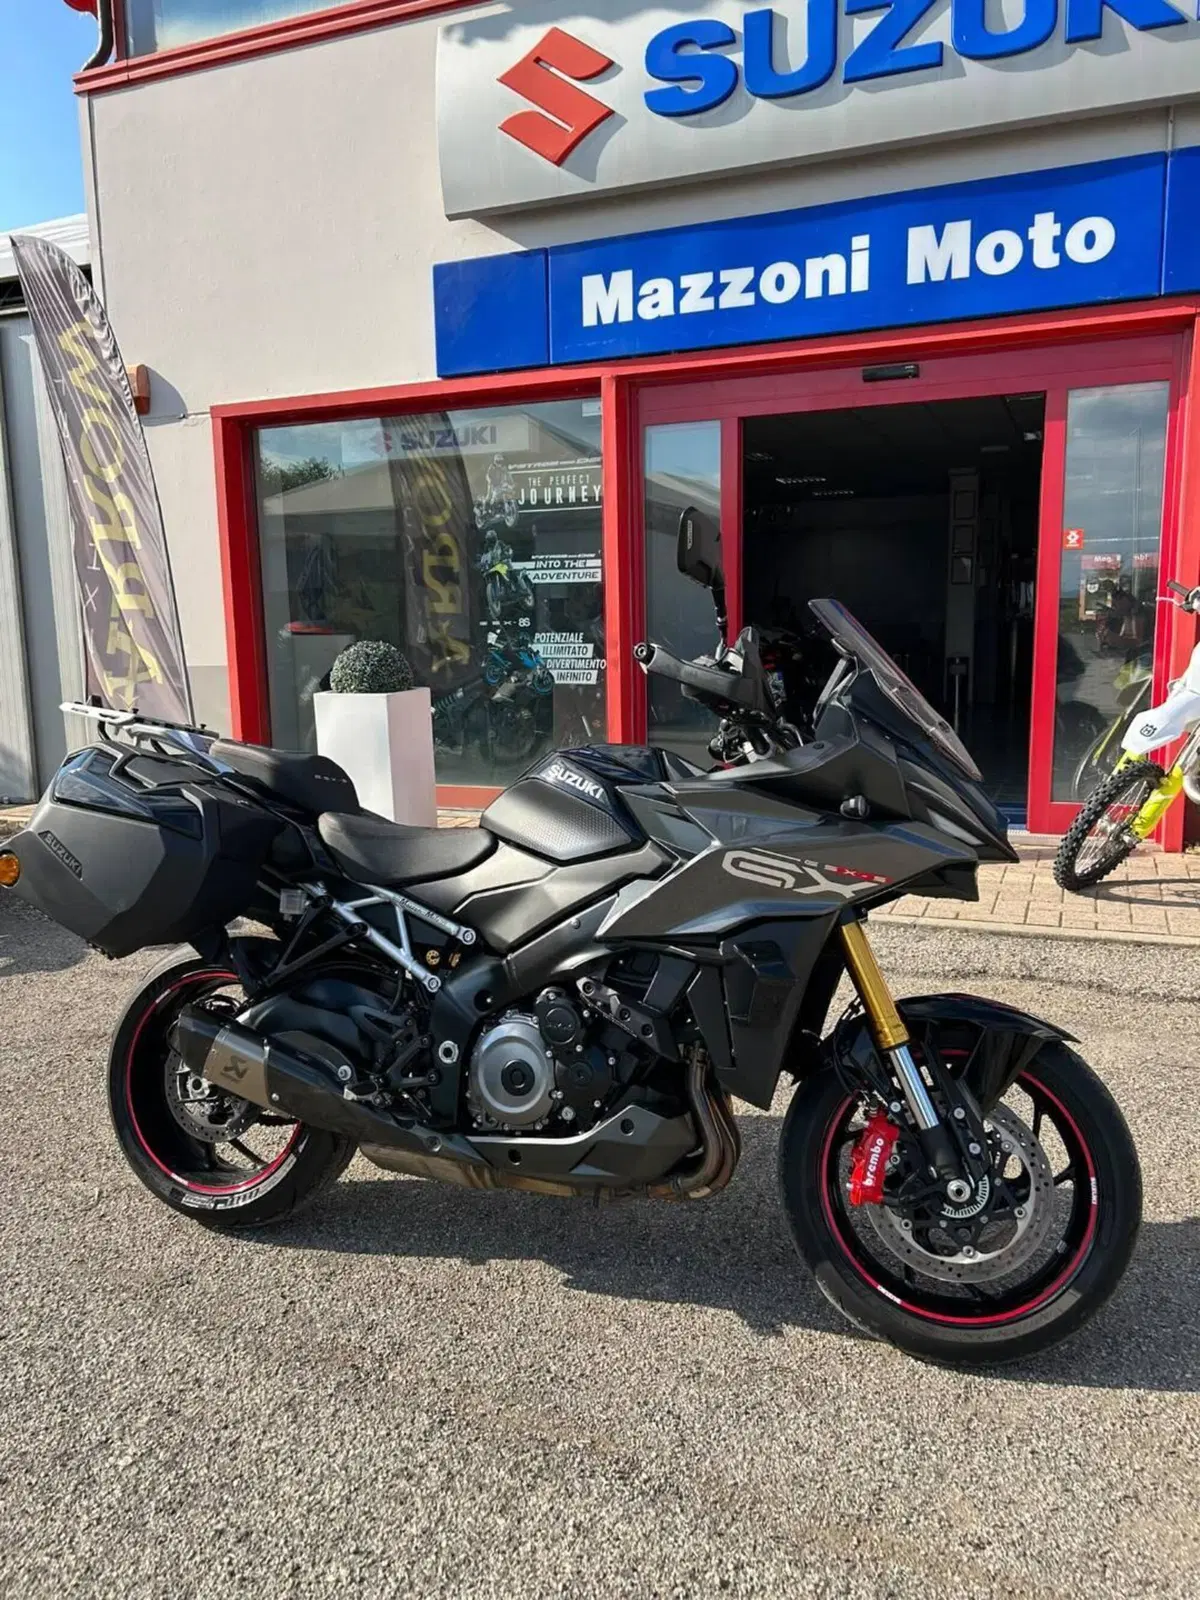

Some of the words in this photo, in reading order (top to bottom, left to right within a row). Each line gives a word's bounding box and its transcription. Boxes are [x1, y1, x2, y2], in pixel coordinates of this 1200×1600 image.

[643, 0, 1200, 117] SUZU
[581, 235, 870, 328] Mazzoni
[906, 211, 1116, 285] Moto
[528, 477, 541, 487] THE
[549, 474, 590, 486] PERFECT
[518, 485, 601, 505] JOURNEY
[536, 561, 560, 569] INTO
[564, 560, 586, 568] THE
[532, 571, 599, 581] ADVENTURE
[534, 632, 584, 643] POTENZIALE
[542, 646, 588, 656] ILLIMITATO
[546, 658, 607, 669] DIVERTIMENTO
[556, 671, 592, 681] INFINITO
[549, 763, 604, 800] SUZUKI
[45, 833, 83, 877] SUZUKI
[864, 1137, 884, 1188] brembo
